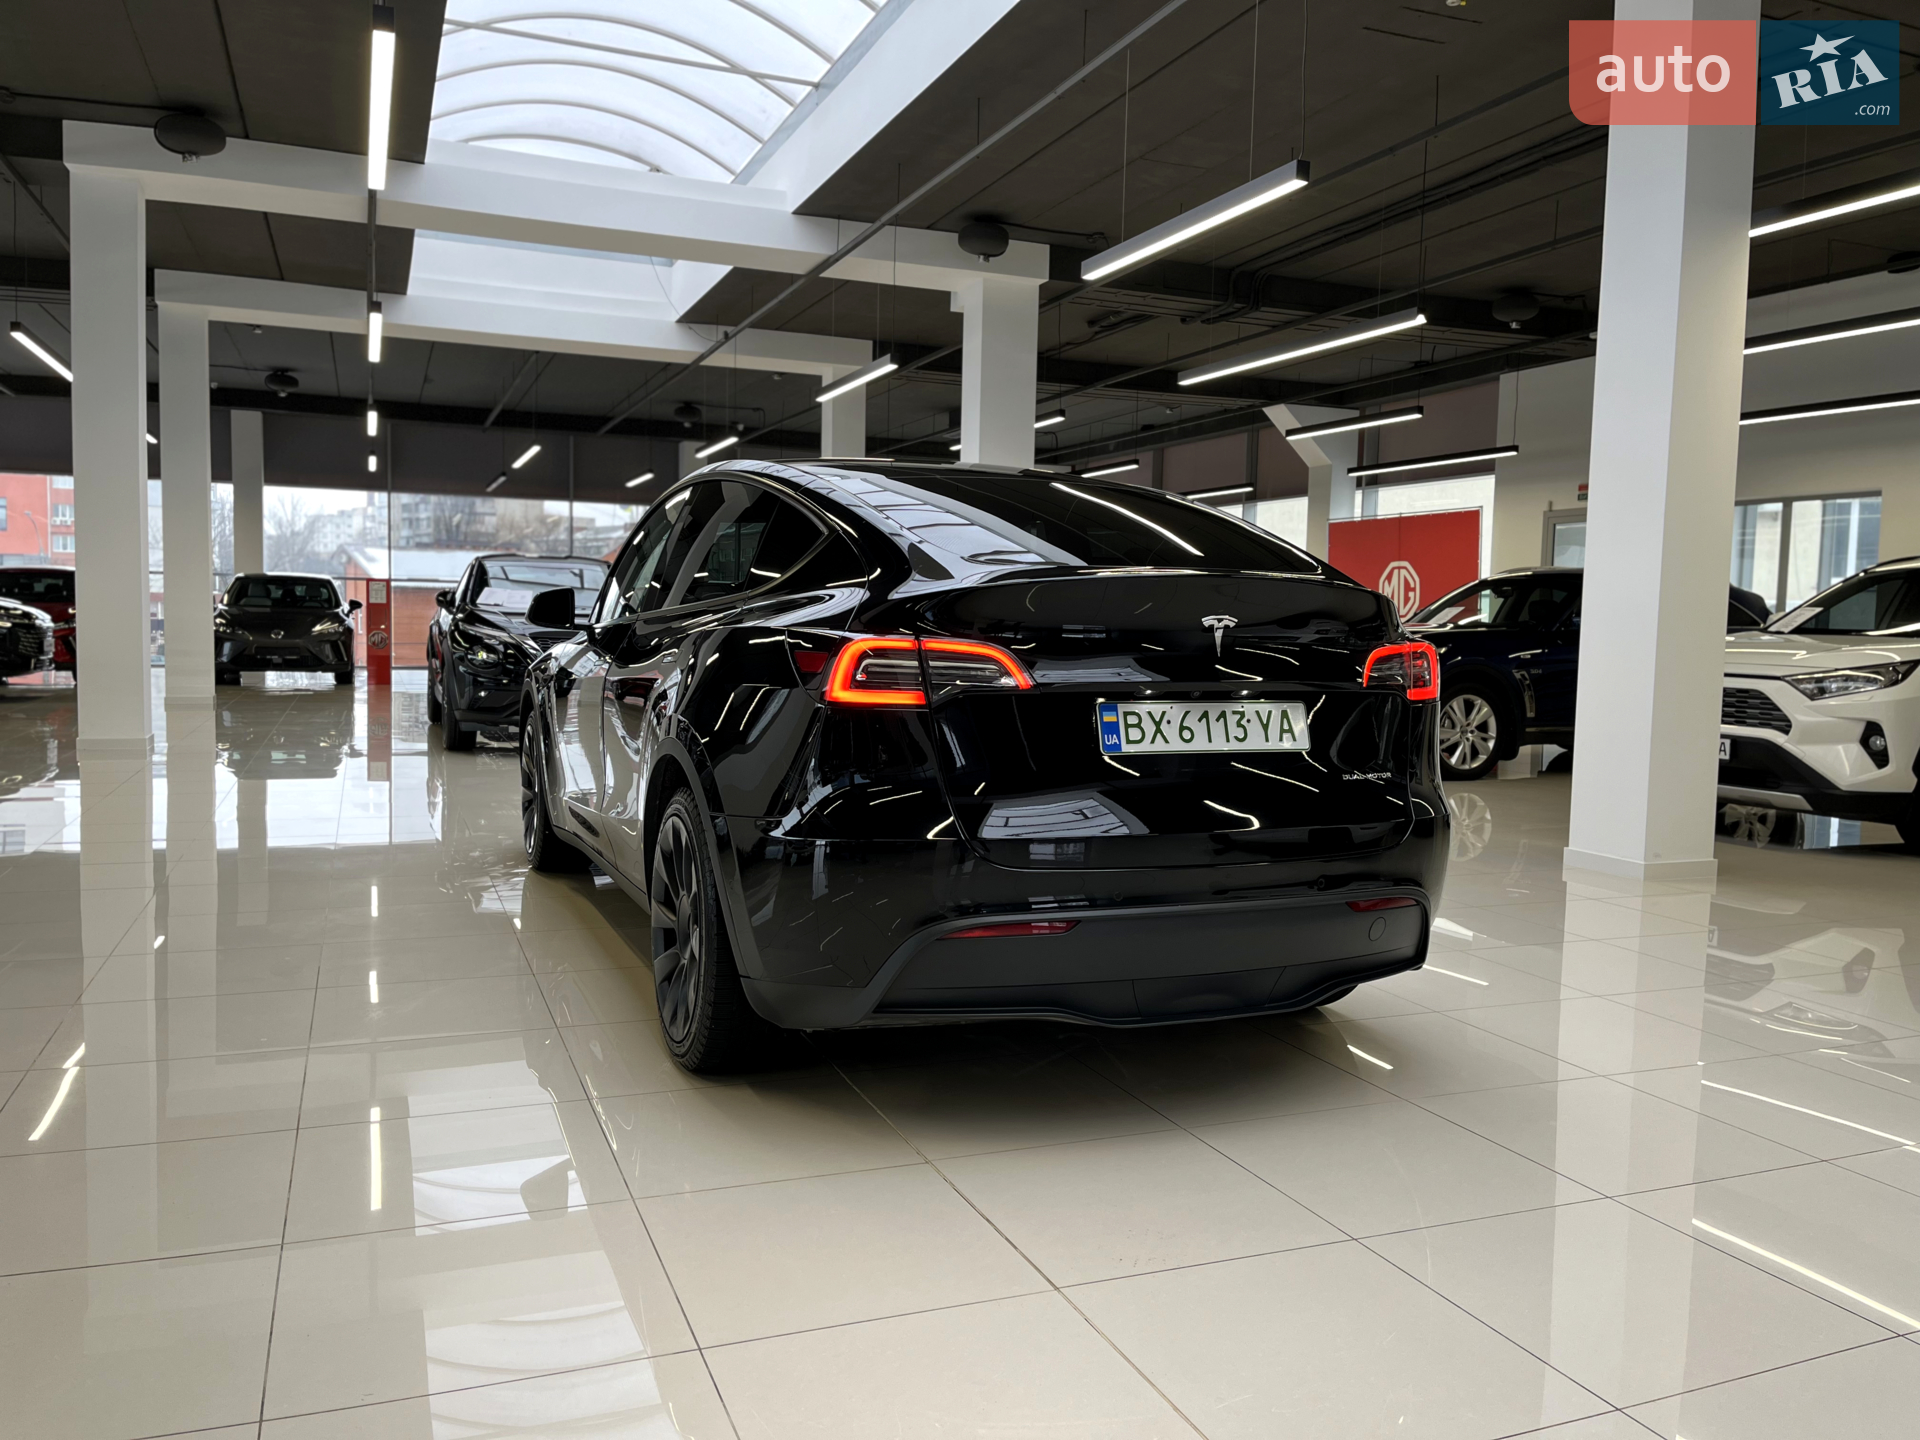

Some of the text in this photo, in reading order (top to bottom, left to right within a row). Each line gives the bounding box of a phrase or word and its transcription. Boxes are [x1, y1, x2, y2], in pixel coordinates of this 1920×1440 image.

[1382, 567, 1416, 617] MG
[370, 632, 386, 648] MG
[1104, 734, 1120, 745] UA
[1122, 709, 1297, 745] BX 6113 YA
